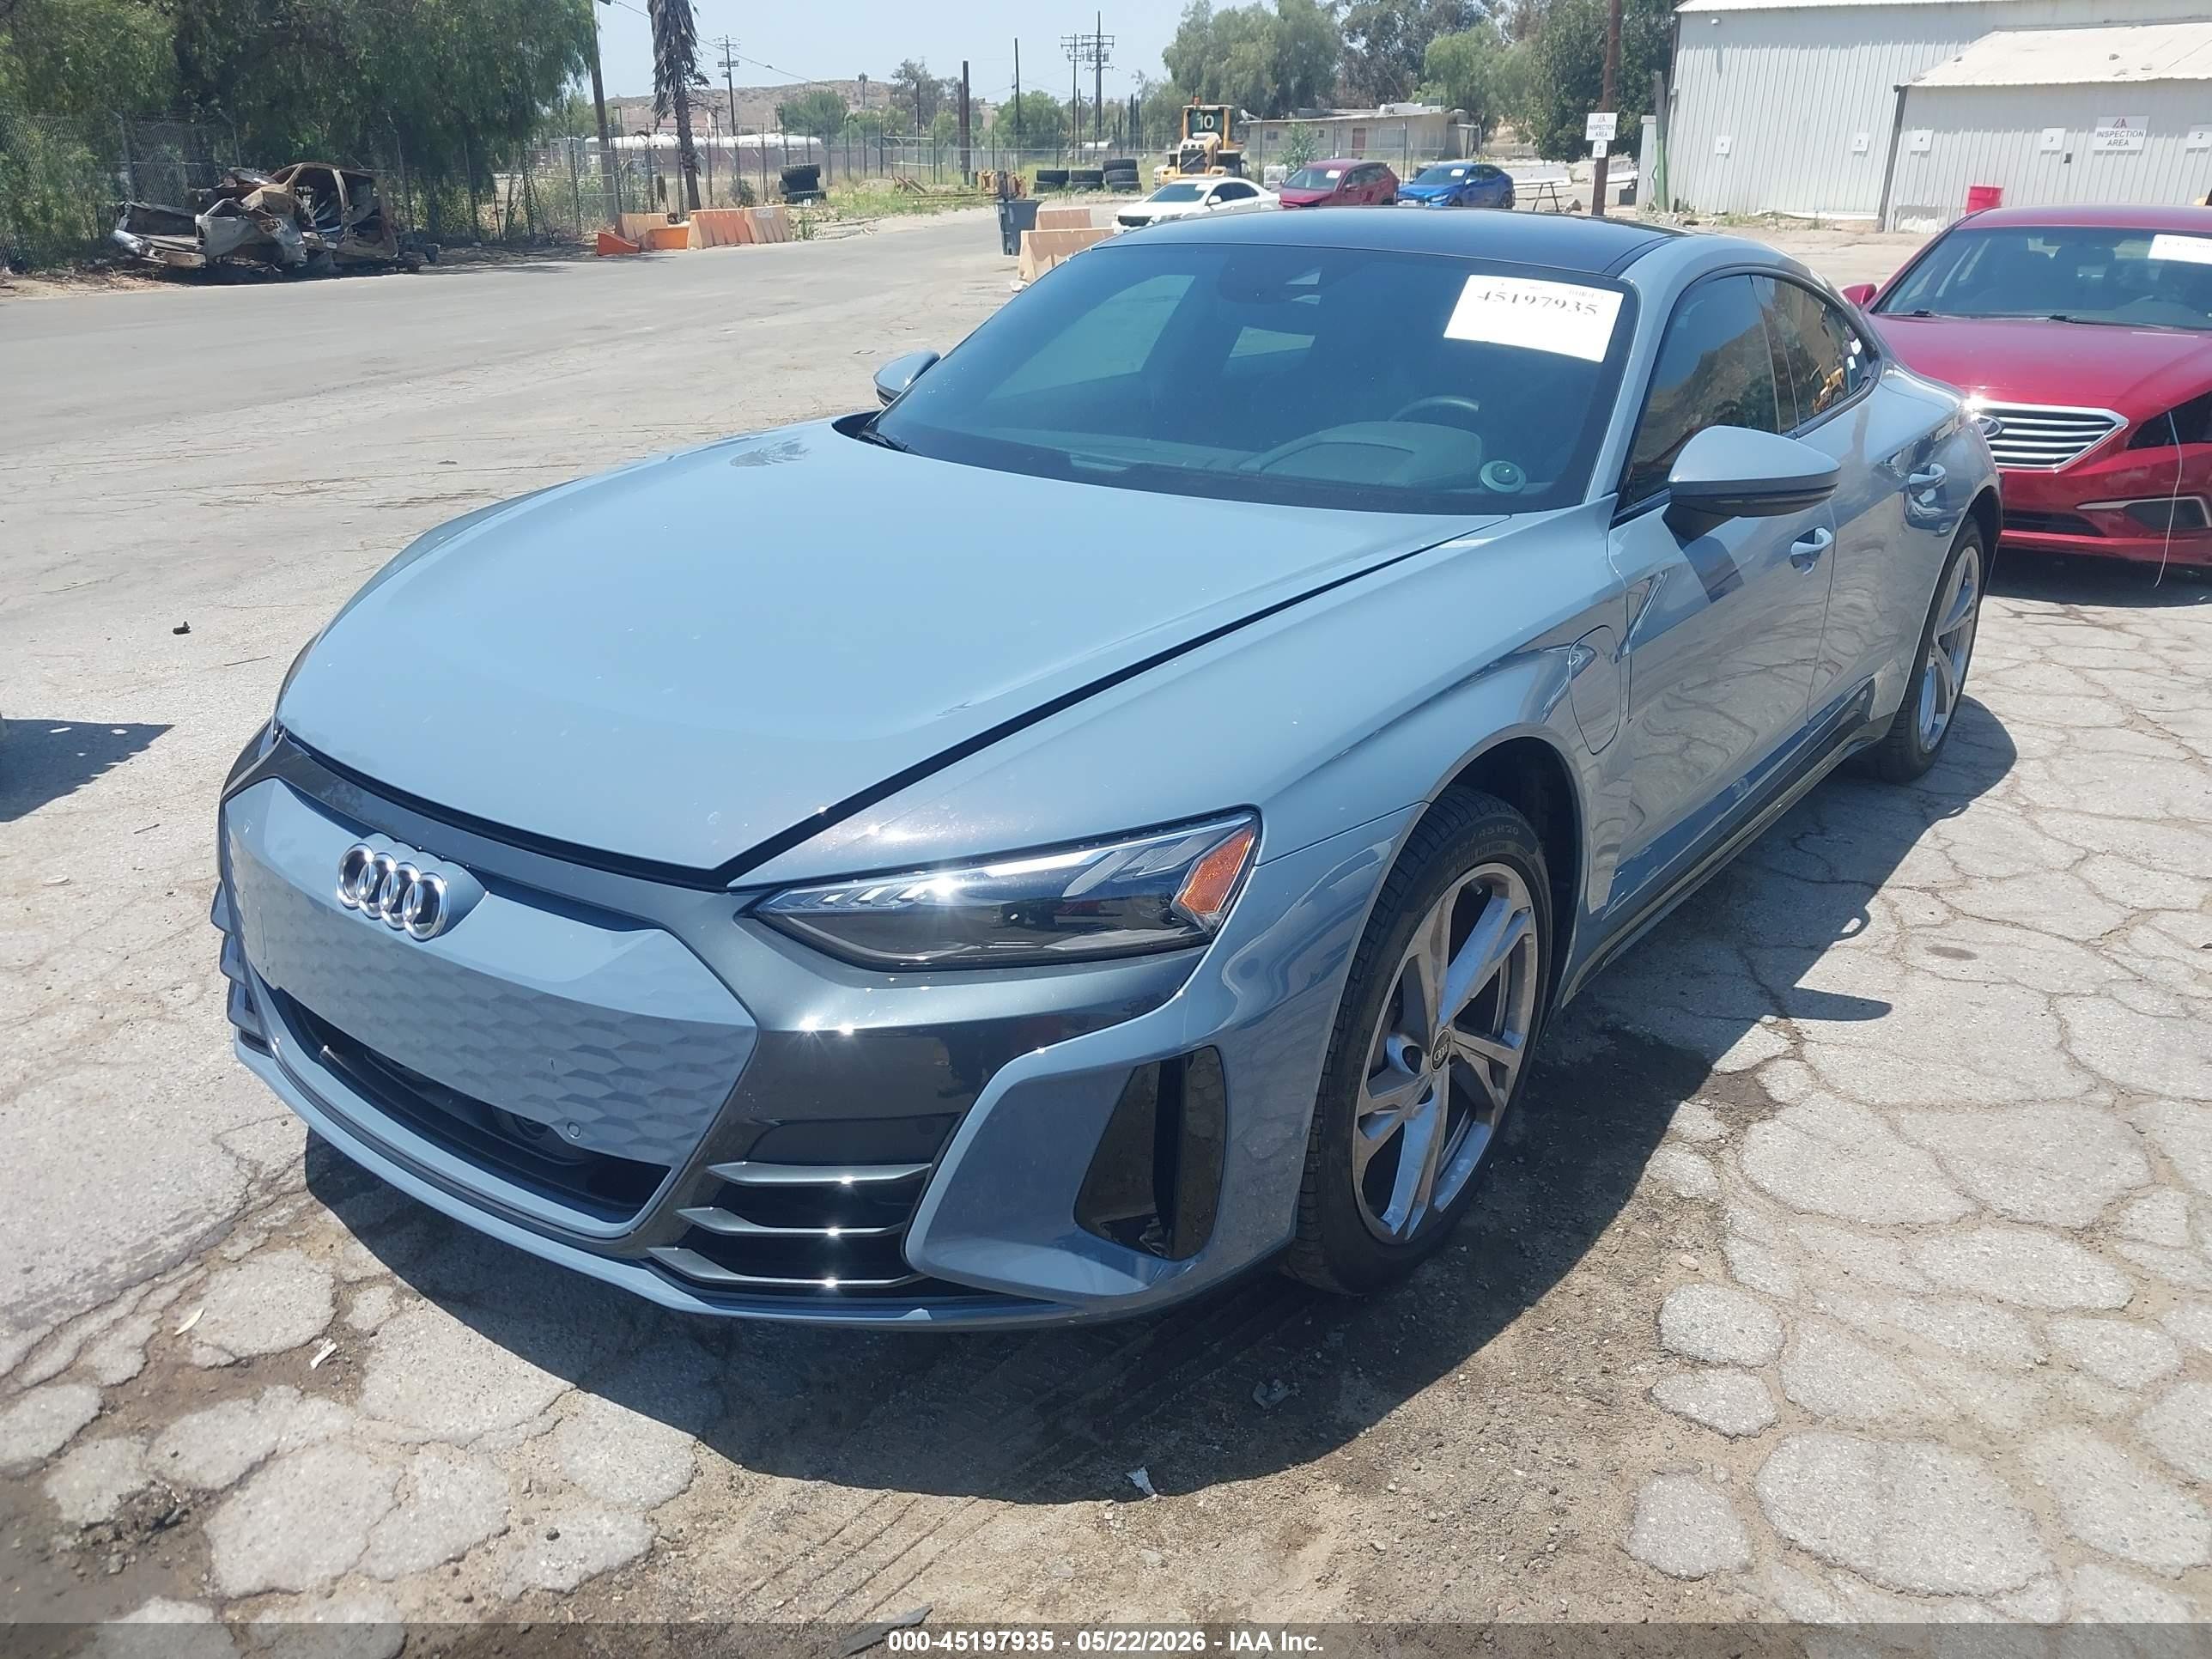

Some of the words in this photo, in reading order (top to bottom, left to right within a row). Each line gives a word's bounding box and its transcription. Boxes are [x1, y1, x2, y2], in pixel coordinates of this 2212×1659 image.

[1196, 112, 1214, 130] 10
[2096, 130, 2144, 138] INSPECTION
[1477, 290, 1598, 315] 45197935
